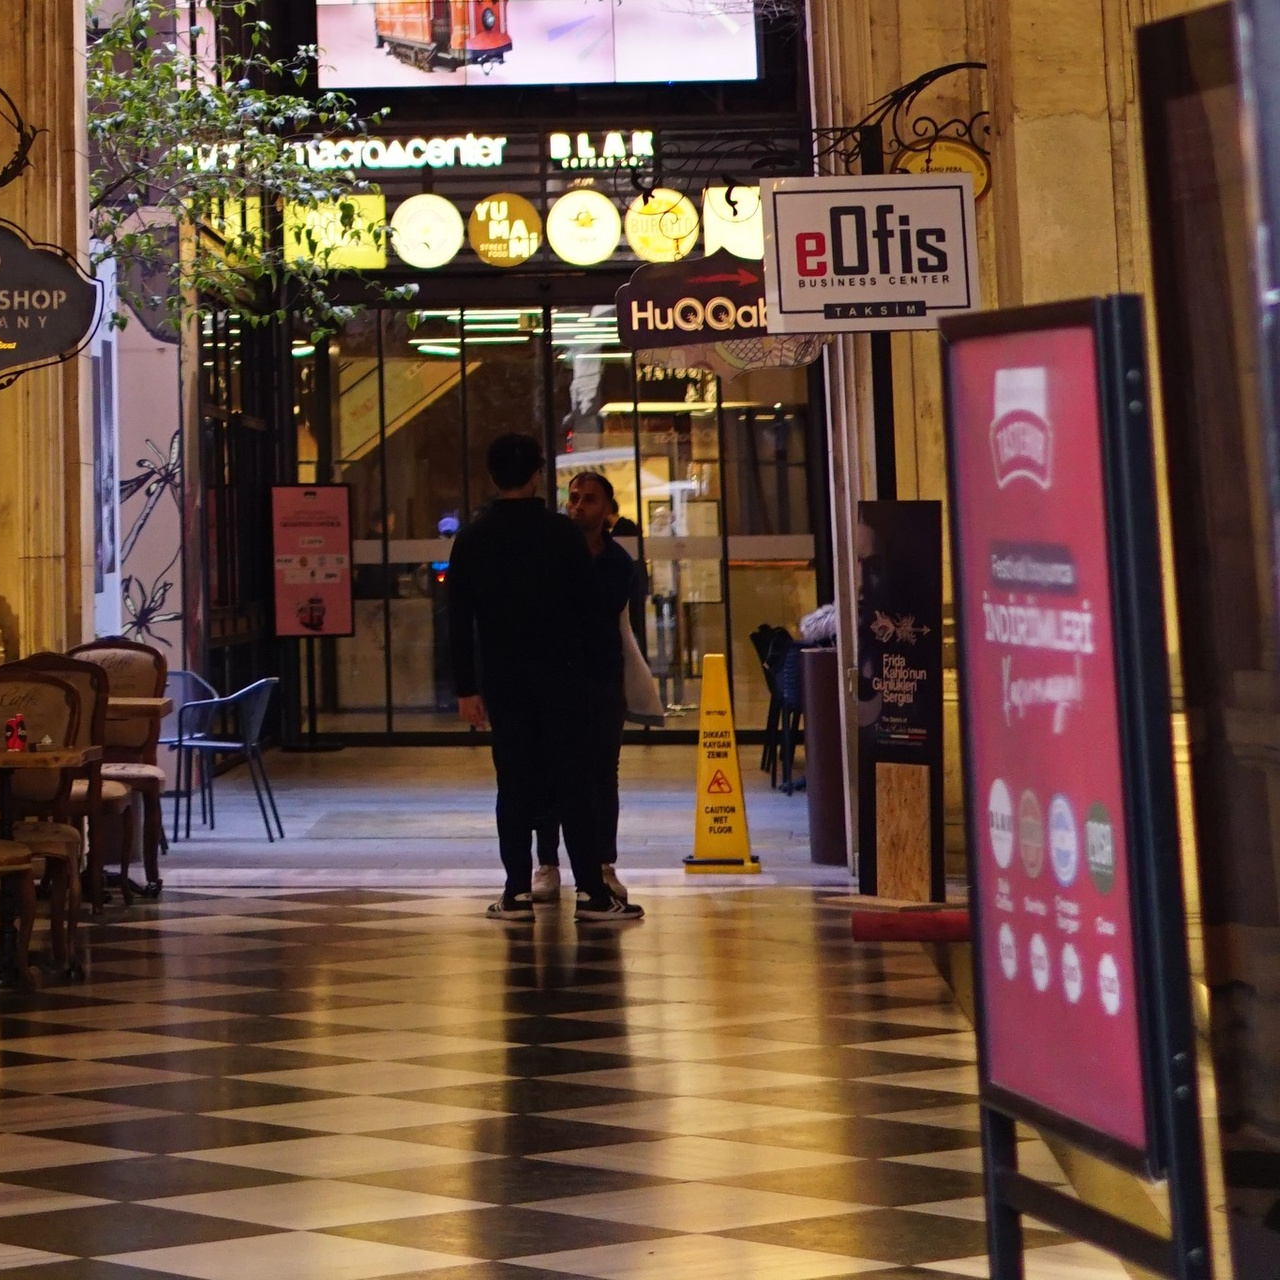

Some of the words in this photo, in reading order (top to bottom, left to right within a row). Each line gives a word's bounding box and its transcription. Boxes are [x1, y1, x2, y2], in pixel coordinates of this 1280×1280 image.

[550, 131, 654, 159] BLAK
[796, 205, 948, 277] eOfis
[479, 243, 507, 251] STREET
[889, 274, 950, 285] CENTER
[883, 653, 905, 667] Frida
[705, 806, 735, 815] CAUTION
[713, 816, 728, 824] WET
[709, 826, 732, 834] FLOOR
